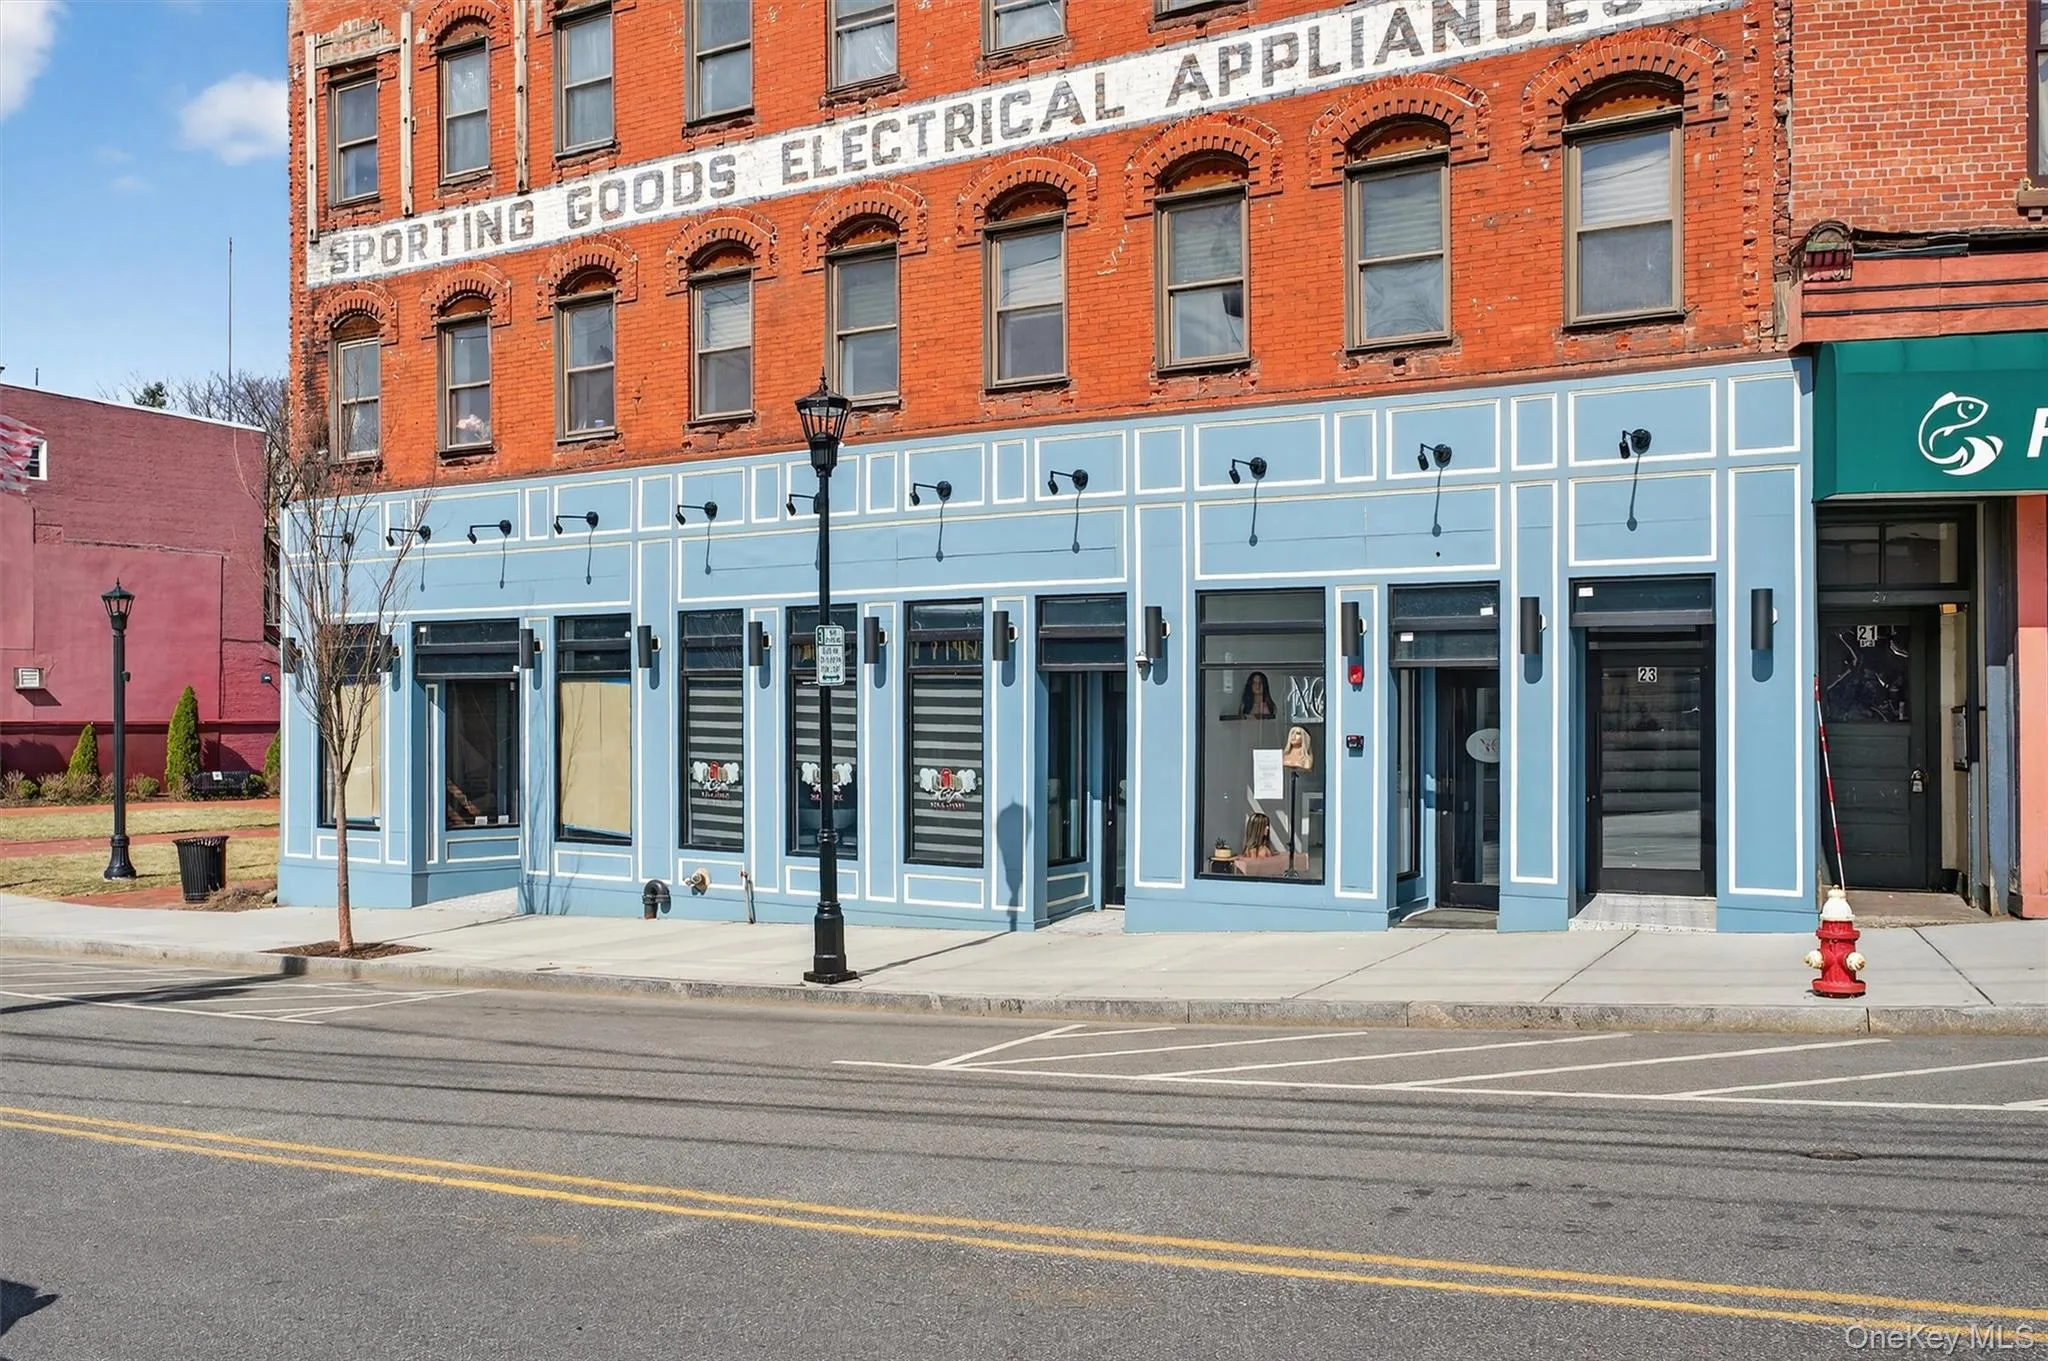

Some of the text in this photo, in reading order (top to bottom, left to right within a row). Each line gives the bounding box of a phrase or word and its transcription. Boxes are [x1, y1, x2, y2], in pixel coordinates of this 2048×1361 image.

[329, 0, 1642, 275] SPORTING GOODS ELECTRICAL APPLIANCE
[1859, 625, 1876, 640] 21
[1640, 667, 1656, 682] 23
